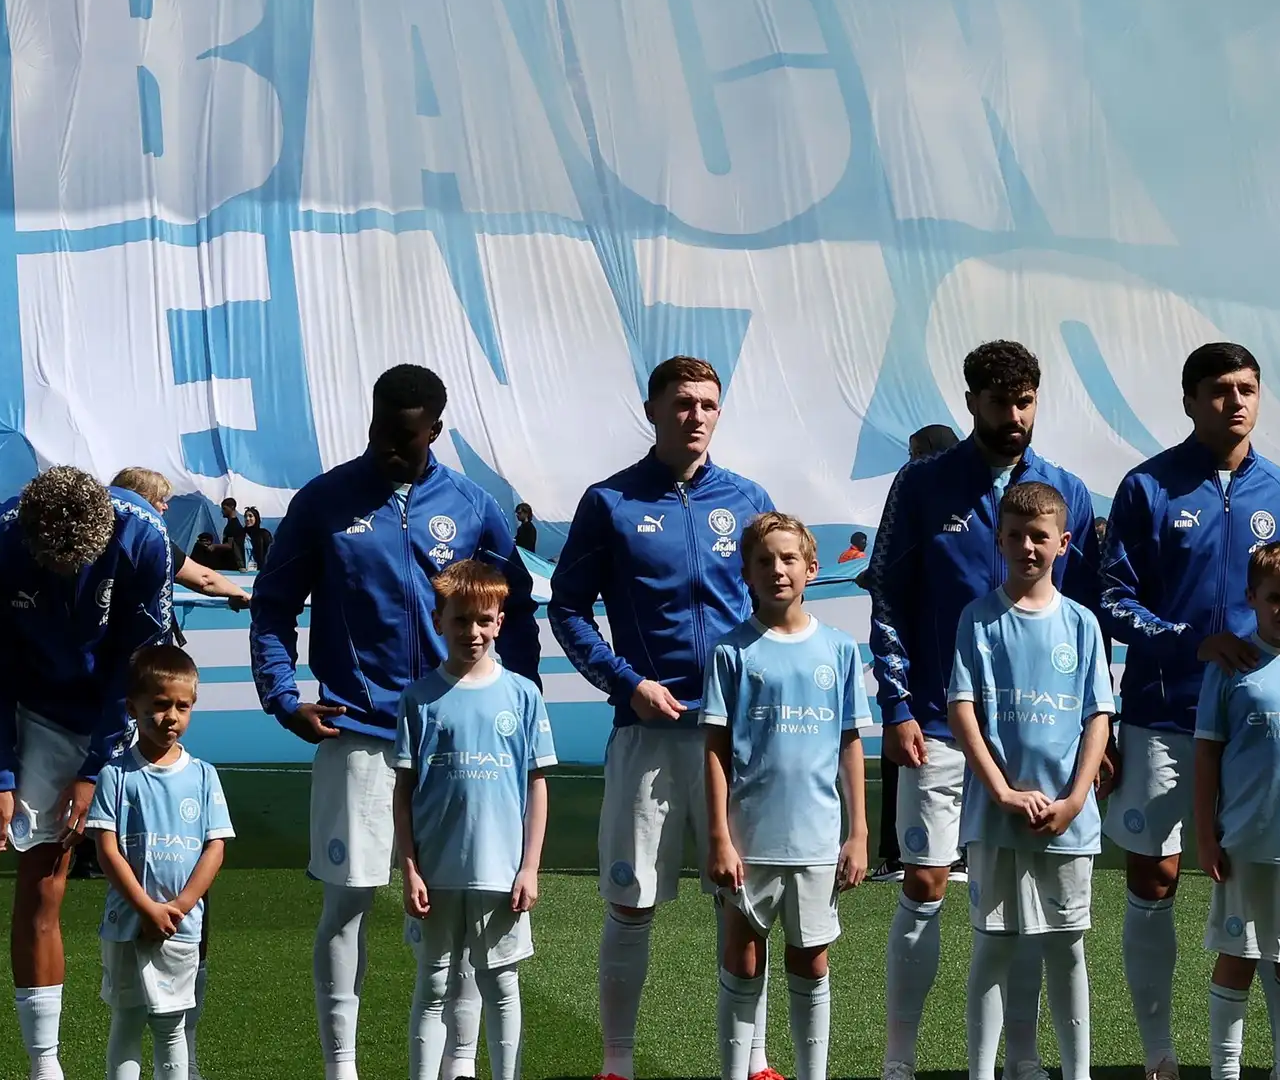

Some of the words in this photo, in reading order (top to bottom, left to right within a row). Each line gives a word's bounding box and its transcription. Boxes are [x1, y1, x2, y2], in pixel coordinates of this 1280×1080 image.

[637, 524, 656, 532] KING
[943, 524, 961, 532] KING
[1174, 519, 1193, 528] KING
[346, 525, 365, 534] KING
[981, 686, 1081, 711] ETIHAD
[748, 705, 835, 721] ETIHAD
[993, 712, 1057, 725] AIRWAYS
[768, 724, 820, 734] AIRWAYS
[426, 752, 513, 768] ETIHAD
[446, 770, 499, 781] AIRWAYS
[120, 832, 203, 852] ETIHAD
